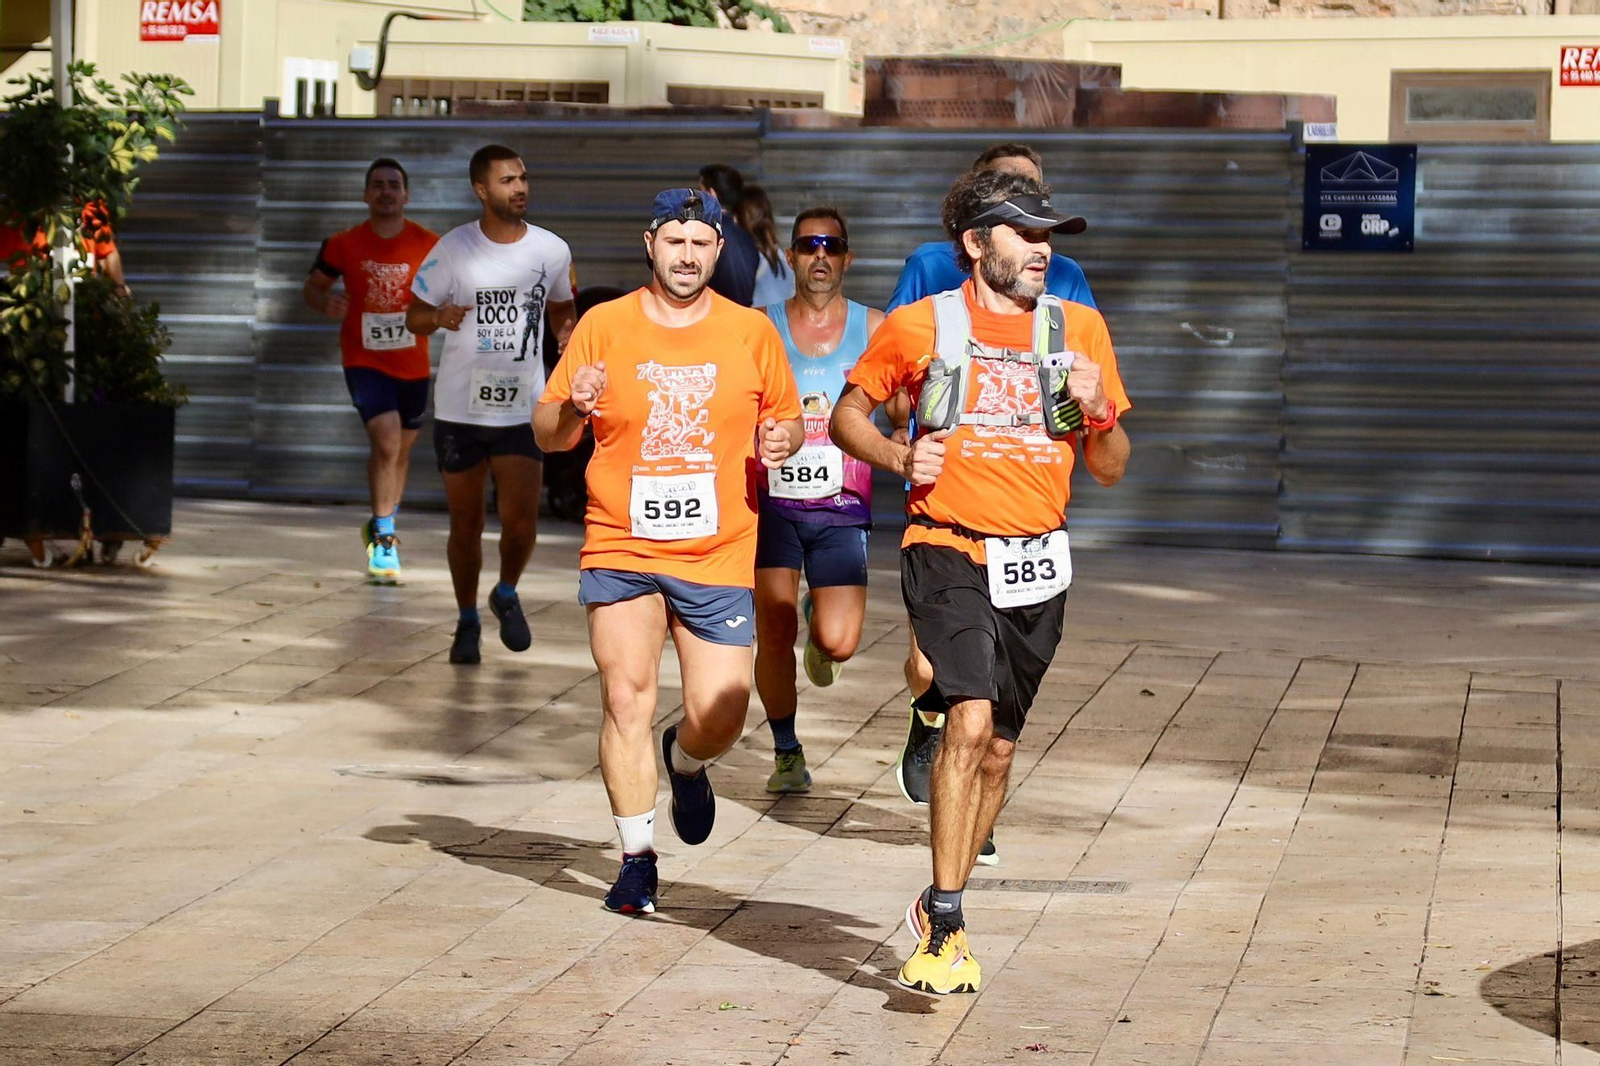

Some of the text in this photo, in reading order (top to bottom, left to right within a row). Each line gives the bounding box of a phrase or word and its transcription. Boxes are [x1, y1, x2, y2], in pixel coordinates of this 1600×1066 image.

[141, 1, 218, 23] REMSA
[1367, 194, 1397, 202] CATEDRAL
[1360, 219, 1390, 236] ORP
[476, 290, 518, 305] ESTOY
[477, 306, 518, 324] LOCO
[370, 325, 405, 339] 517
[477, 327, 516, 338] SOY DE LA
[479, 385, 519, 402] 837
[780, 465, 829, 483] 584
[643, 498, 703, 520] 592
[1003, 557, 1057, 585] 583
